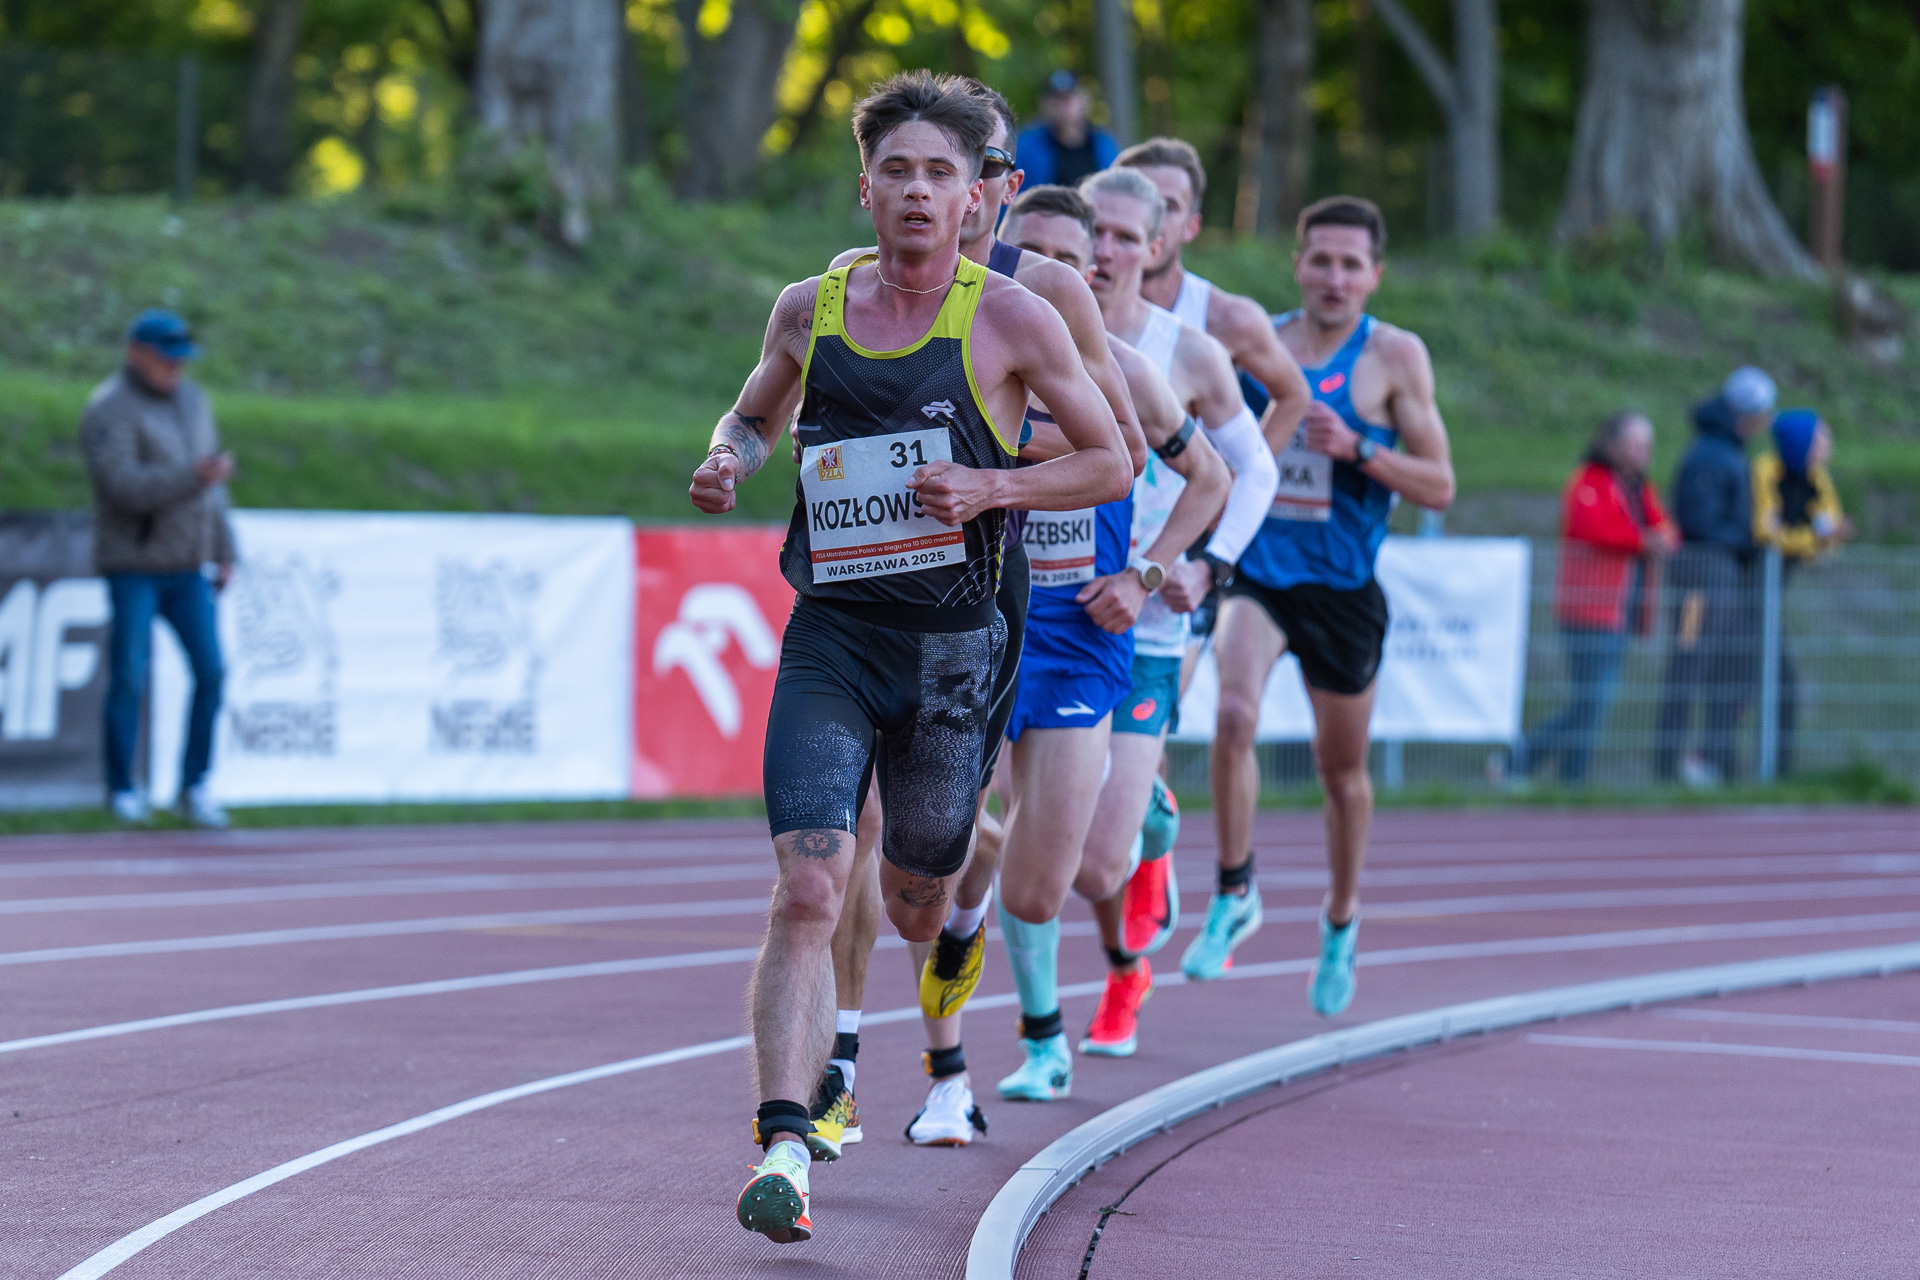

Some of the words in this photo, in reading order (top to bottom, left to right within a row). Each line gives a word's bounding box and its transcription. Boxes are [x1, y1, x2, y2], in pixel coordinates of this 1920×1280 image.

[889, 439, 928, 468] 31
[820, 468, 843, 479] PZLA
[920, 537, 933, 545] 000
[933, 535, 959, 543] metrów
[1024, 518, 1091, 551] ZĘBSKI
[826, 557, 909, 577] WARSZAWA
[911, 550, 946, 566] 2025
[1052, 570, 1080, 582] 2025
